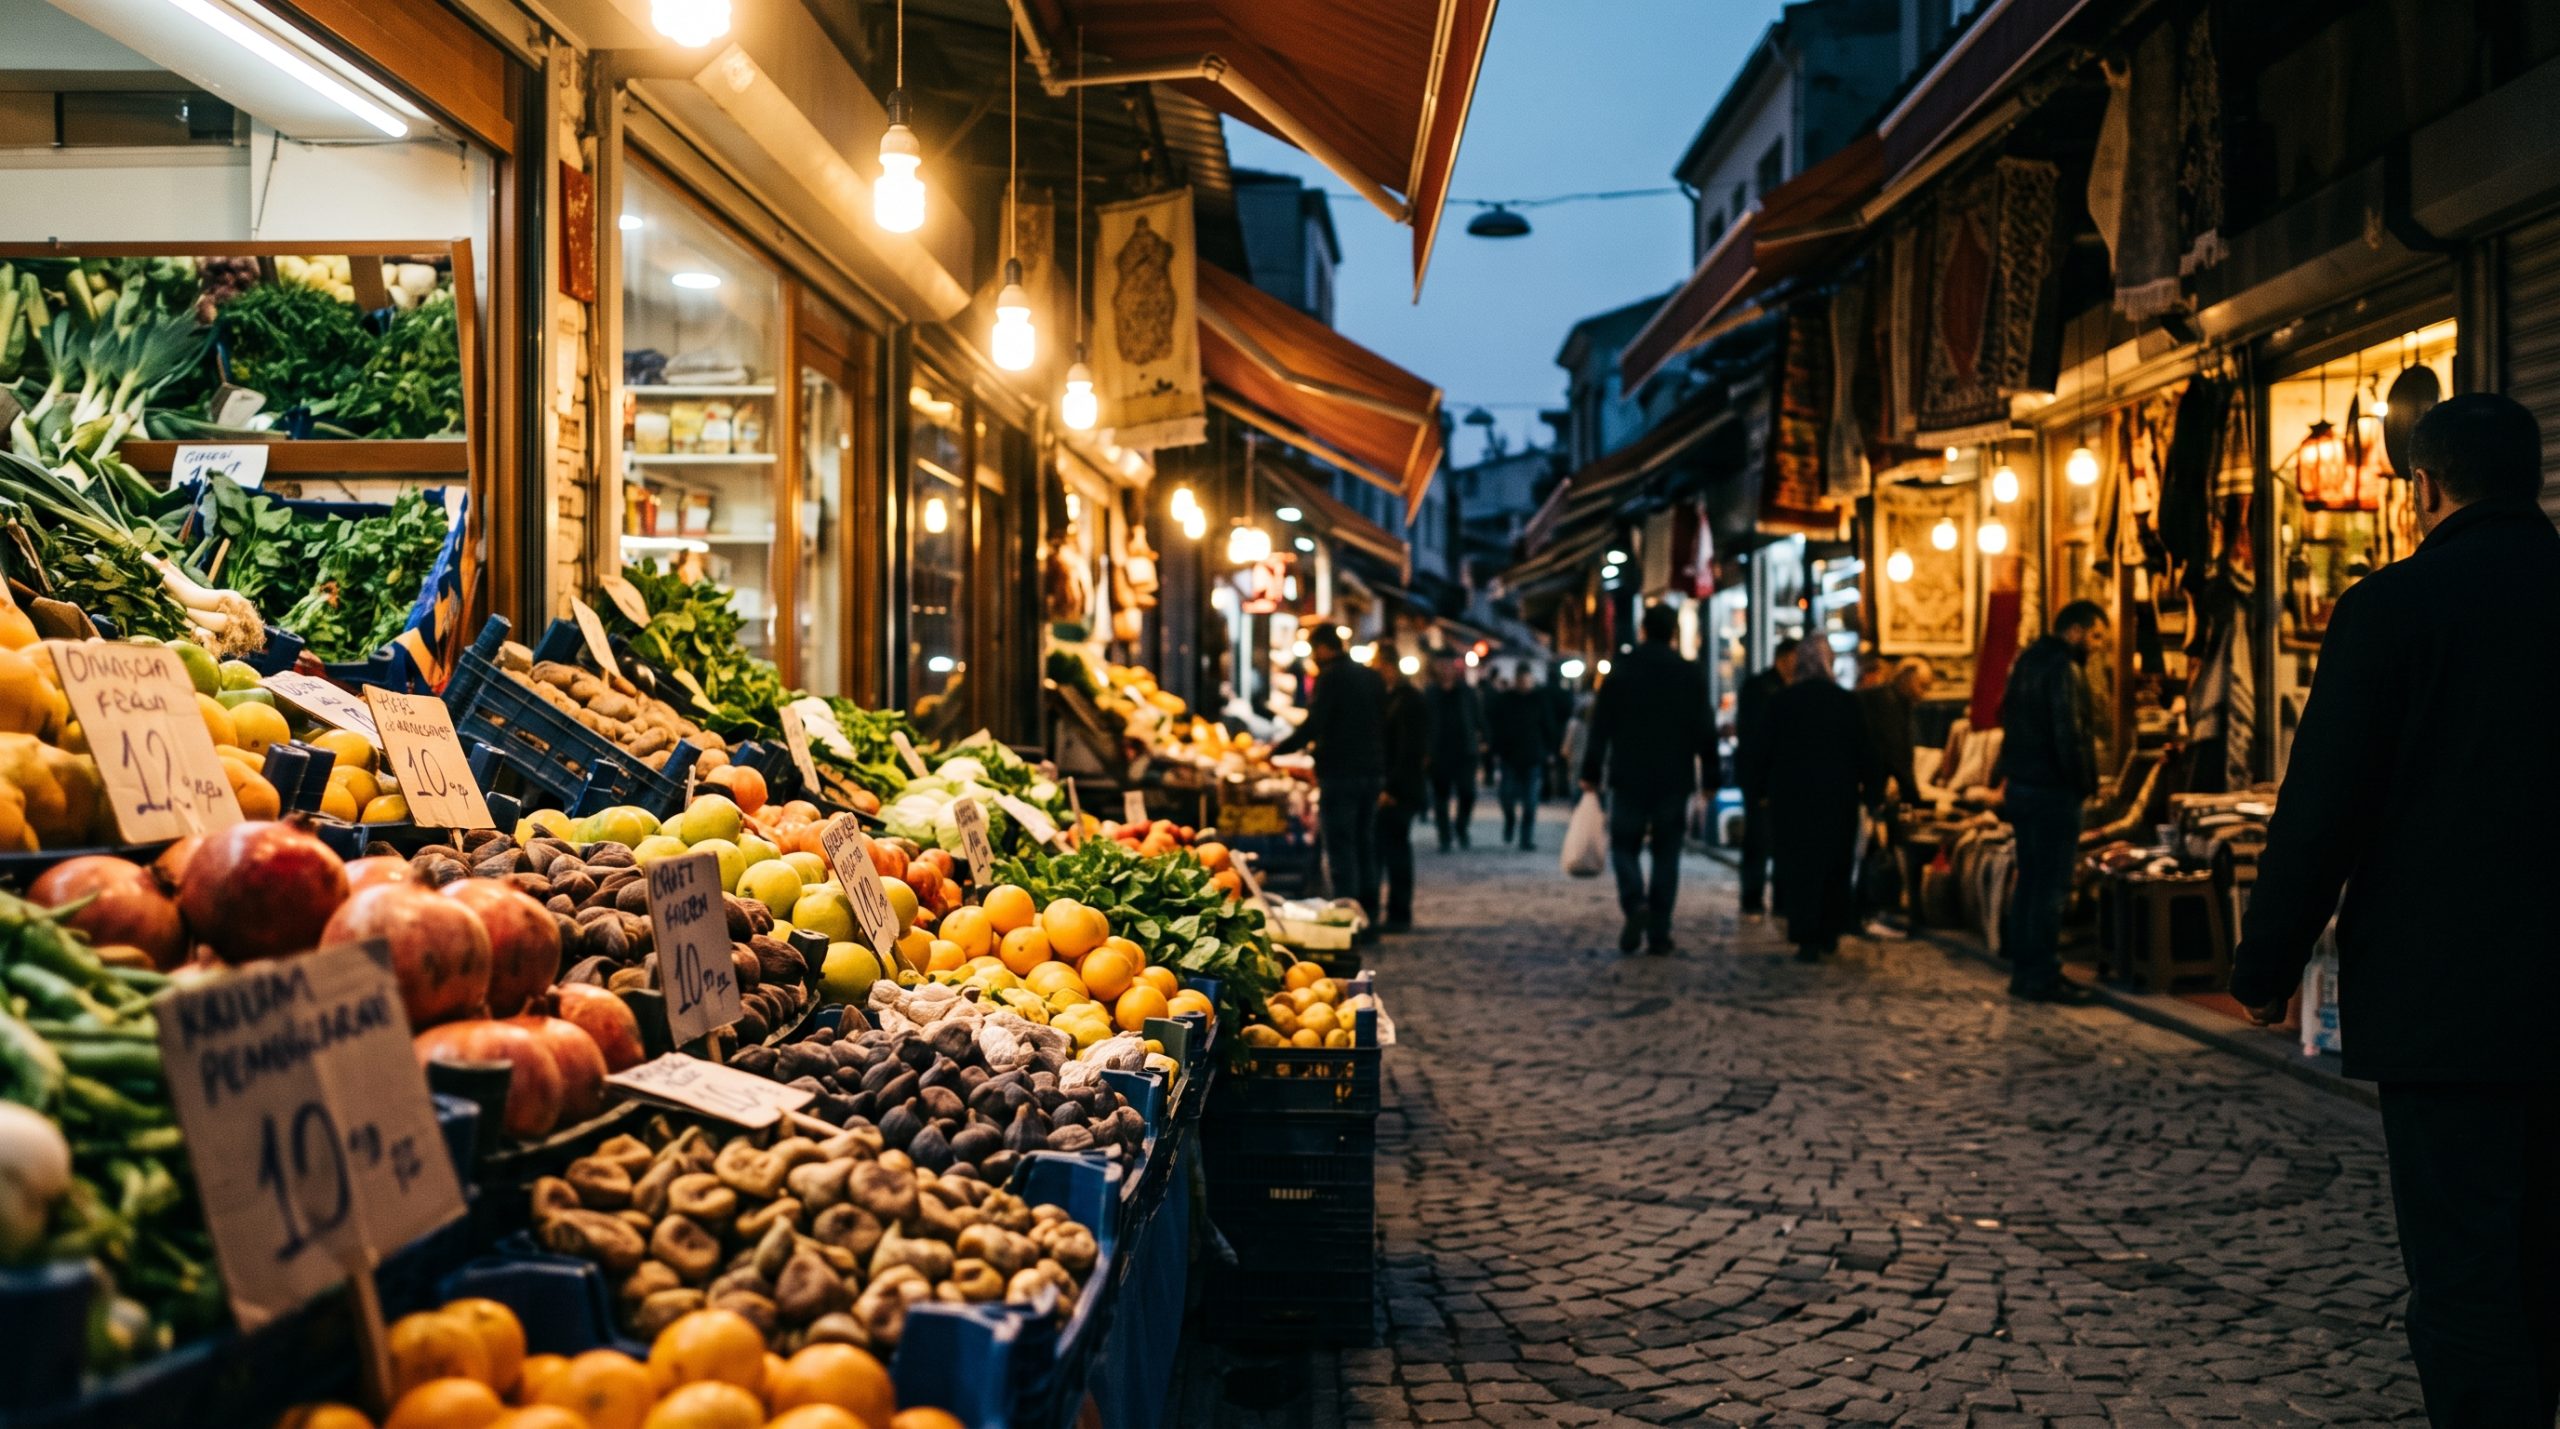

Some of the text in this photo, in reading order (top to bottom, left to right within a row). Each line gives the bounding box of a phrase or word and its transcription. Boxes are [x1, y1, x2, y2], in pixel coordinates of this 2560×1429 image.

[407, 746, 447, 798] 10
[675, 942, 703, 1016] 10
[258, 1102, 352, 1263] 10
